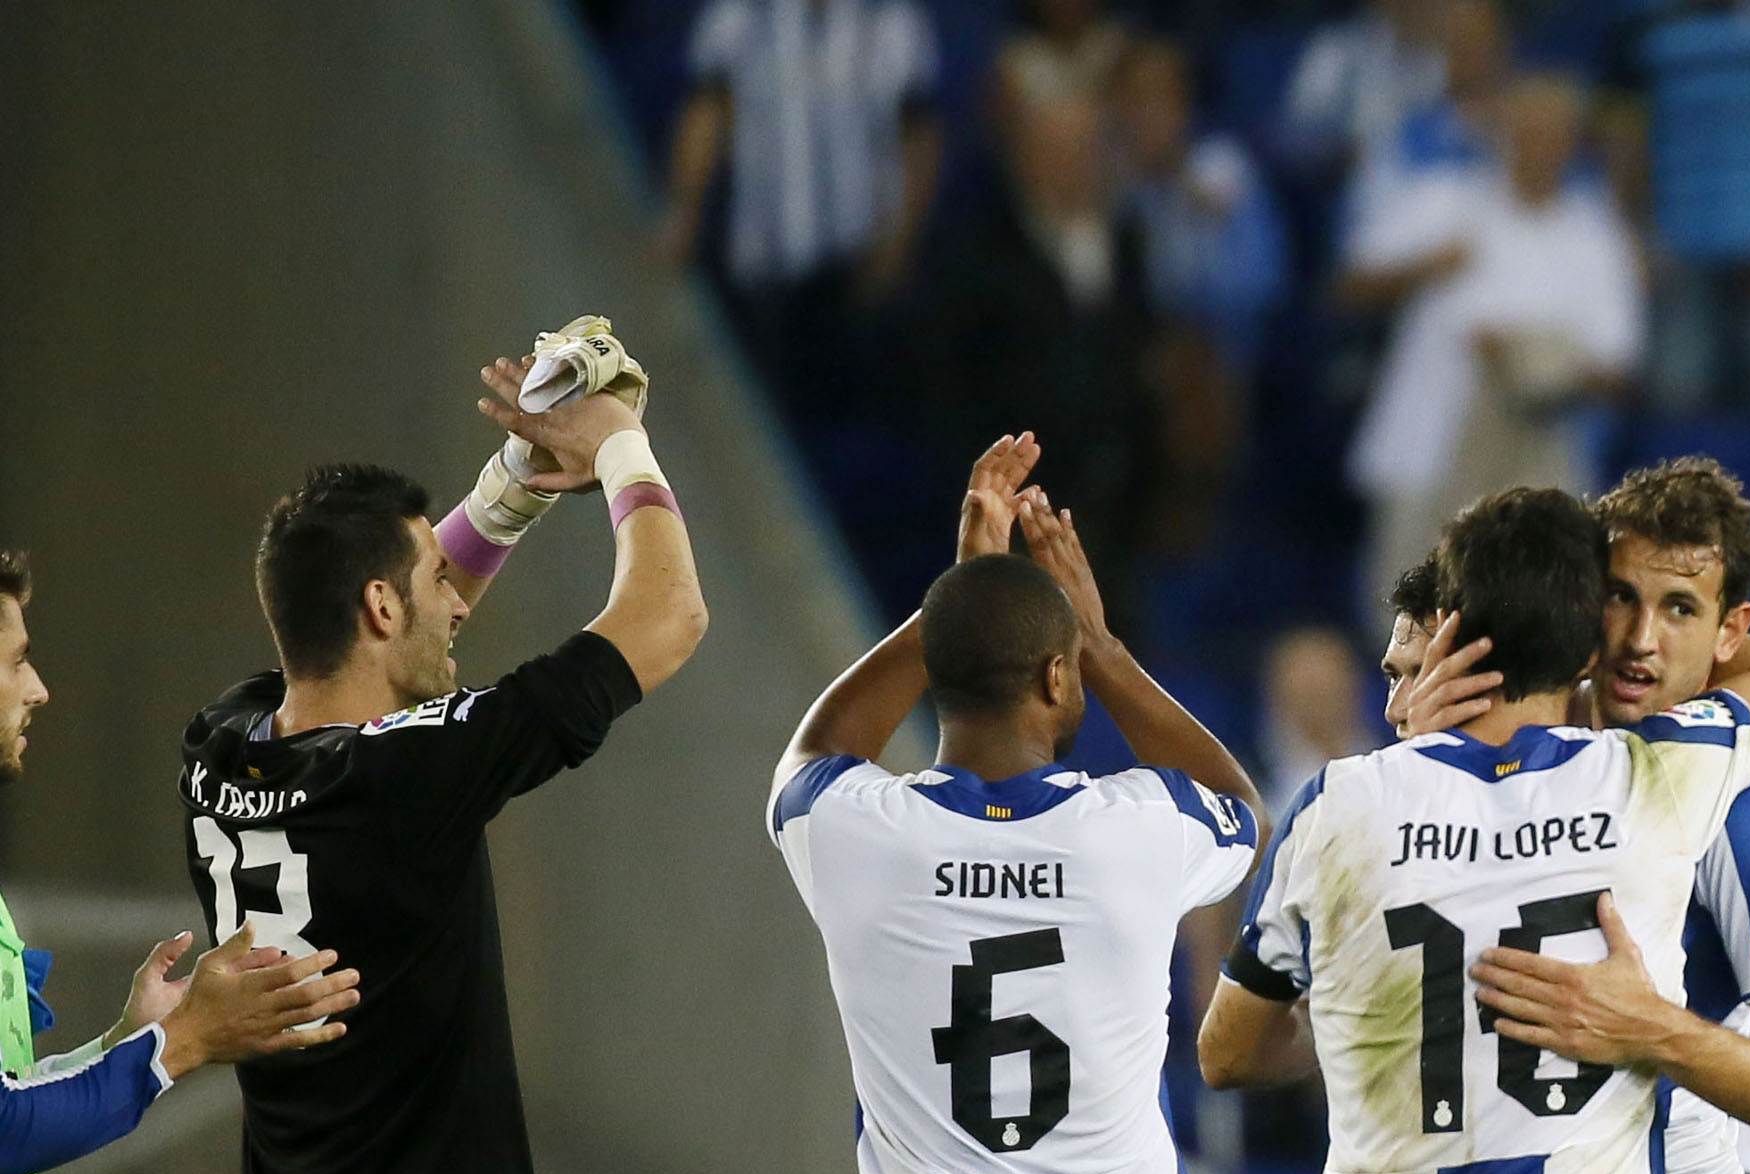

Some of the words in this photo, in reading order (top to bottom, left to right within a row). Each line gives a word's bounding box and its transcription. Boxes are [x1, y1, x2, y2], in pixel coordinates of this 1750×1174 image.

[191, 760, 209, 807] K.
[1390, 822, 1479, 867] JAVI
[1494, 812, 1617, 860] LOPEZ
[934, 861, 1064, 899] SIDNEI
[931, 927, 1071, 1152] 6
